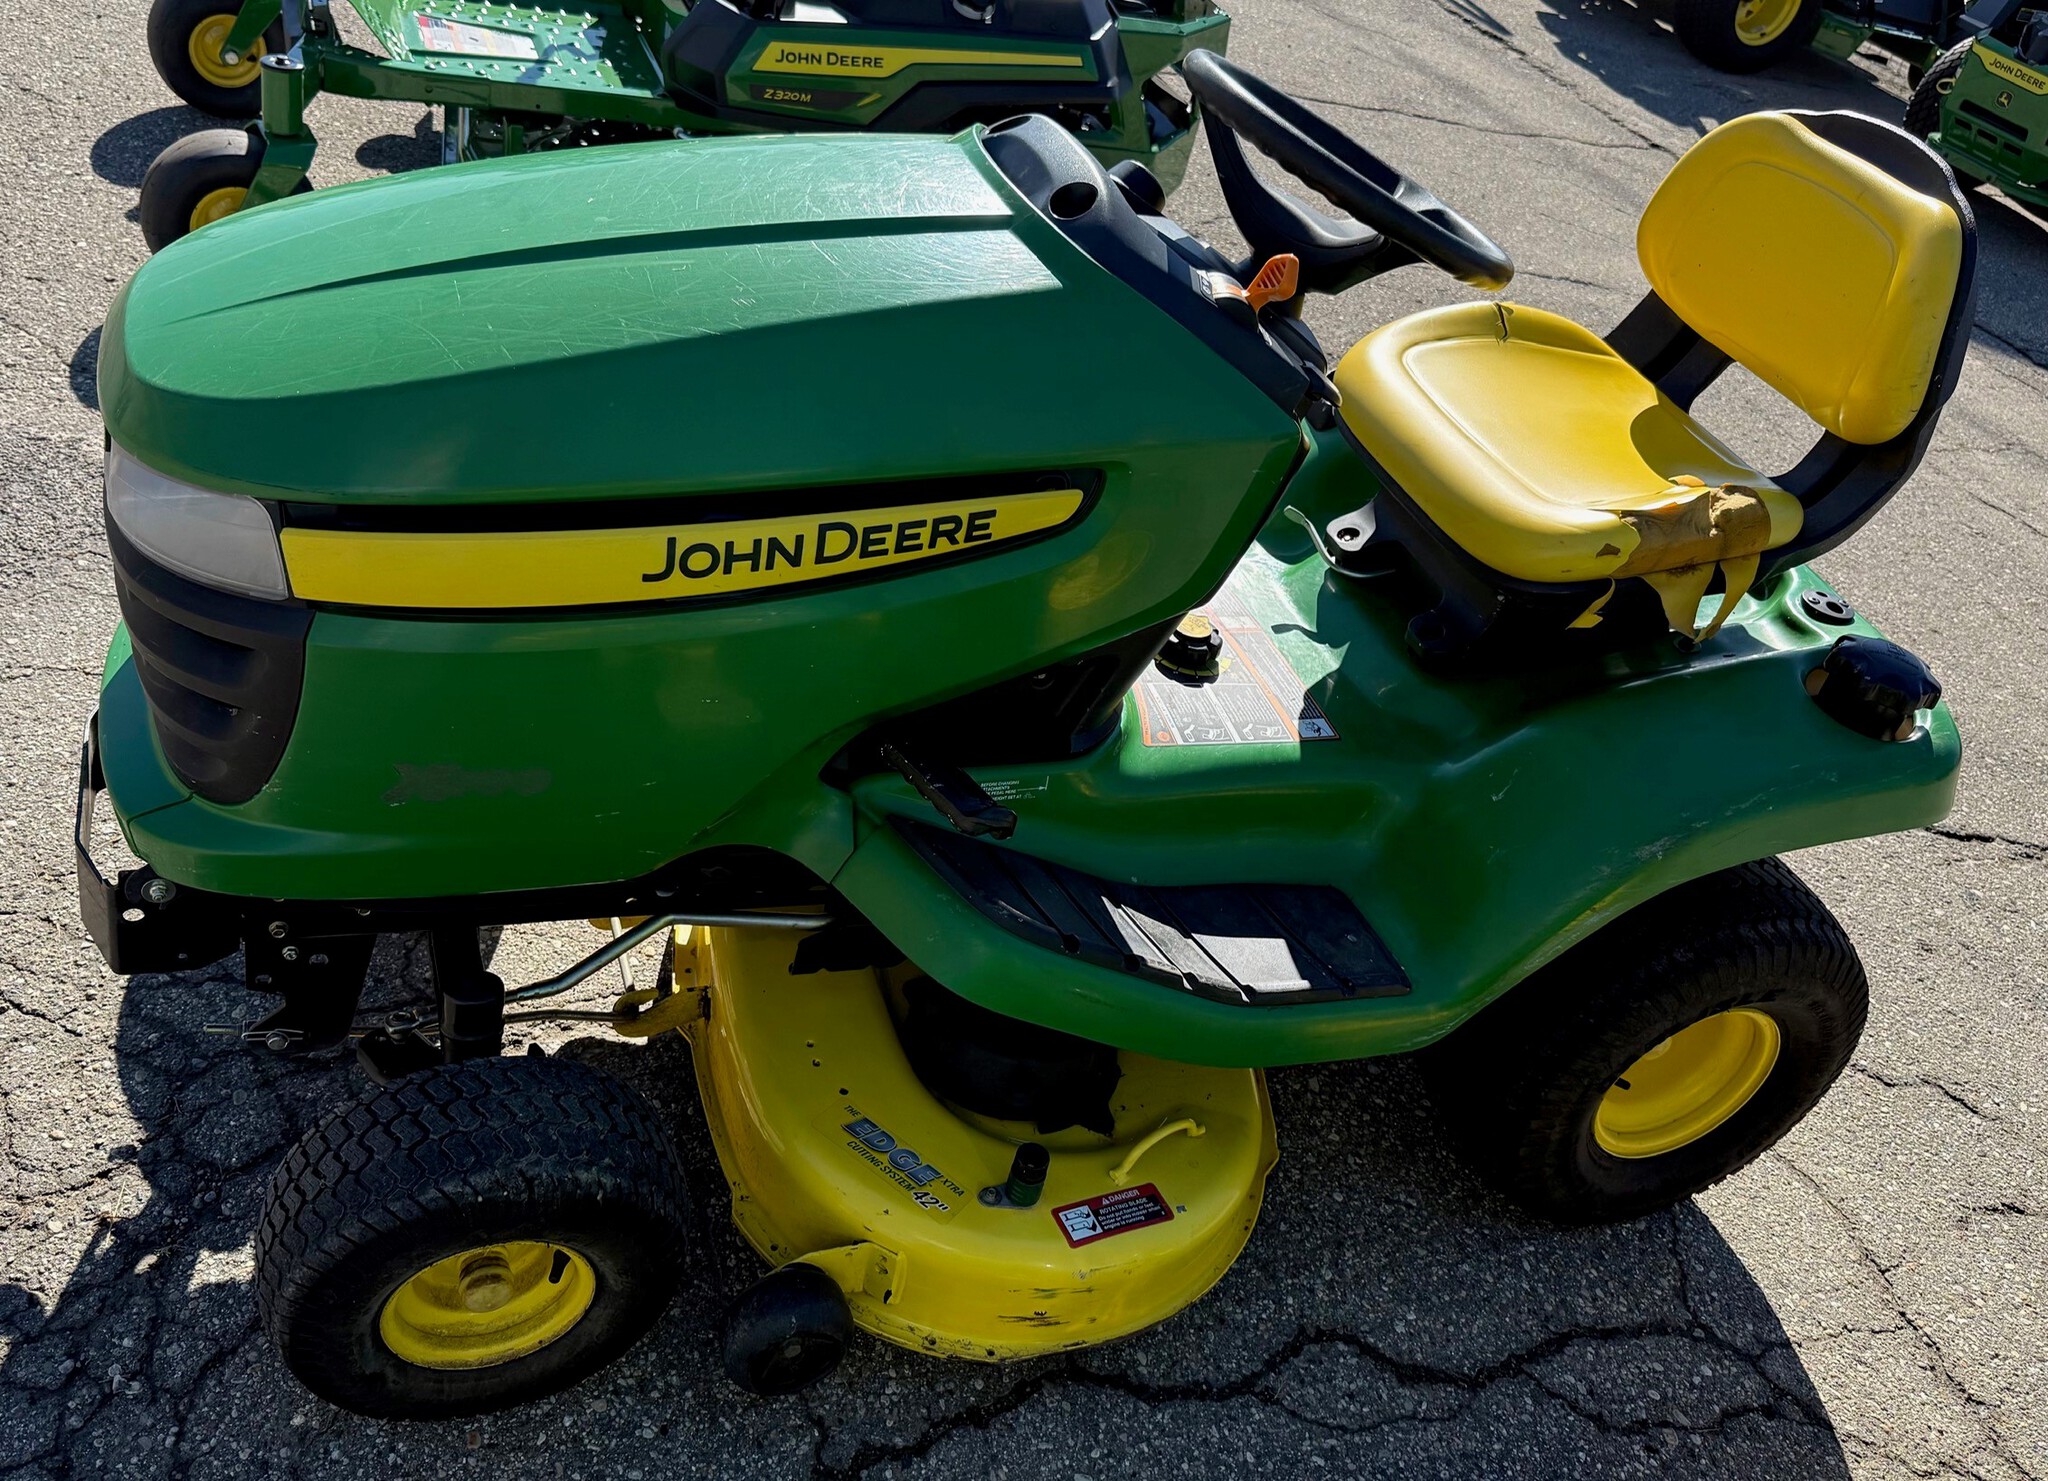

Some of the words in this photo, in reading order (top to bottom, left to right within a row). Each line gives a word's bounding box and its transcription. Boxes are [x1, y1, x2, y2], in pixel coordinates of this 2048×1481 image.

[775, 49, 822, 65] JOHN
[826, 52, 884, 68] DEERE
[1989, 58, 2014, 75] JOHN
[2014, 69, 2046, 90] DEERE
[764, 88, 812, 103] Z320M
[641, 533, 805, 583] JOHN
[813, 509, 997, 565] DEERE
[844, 1104, 862, 1118] THE
[841, 1116, 942, 1187] EDGE
[941, 1178, 965, 1198] XTRA
[846, 1140, 883, 1168] CUTTING
[880, 1165, 915, 1192] SYSTEM
[911, 1190, 951, 1213] 42"
[1108, 1189, 1140, 1203] DANGER
[1099, 1203, 1129, 1215] ROTATING
[1129, 1197, 1148, 1207] BLADE
